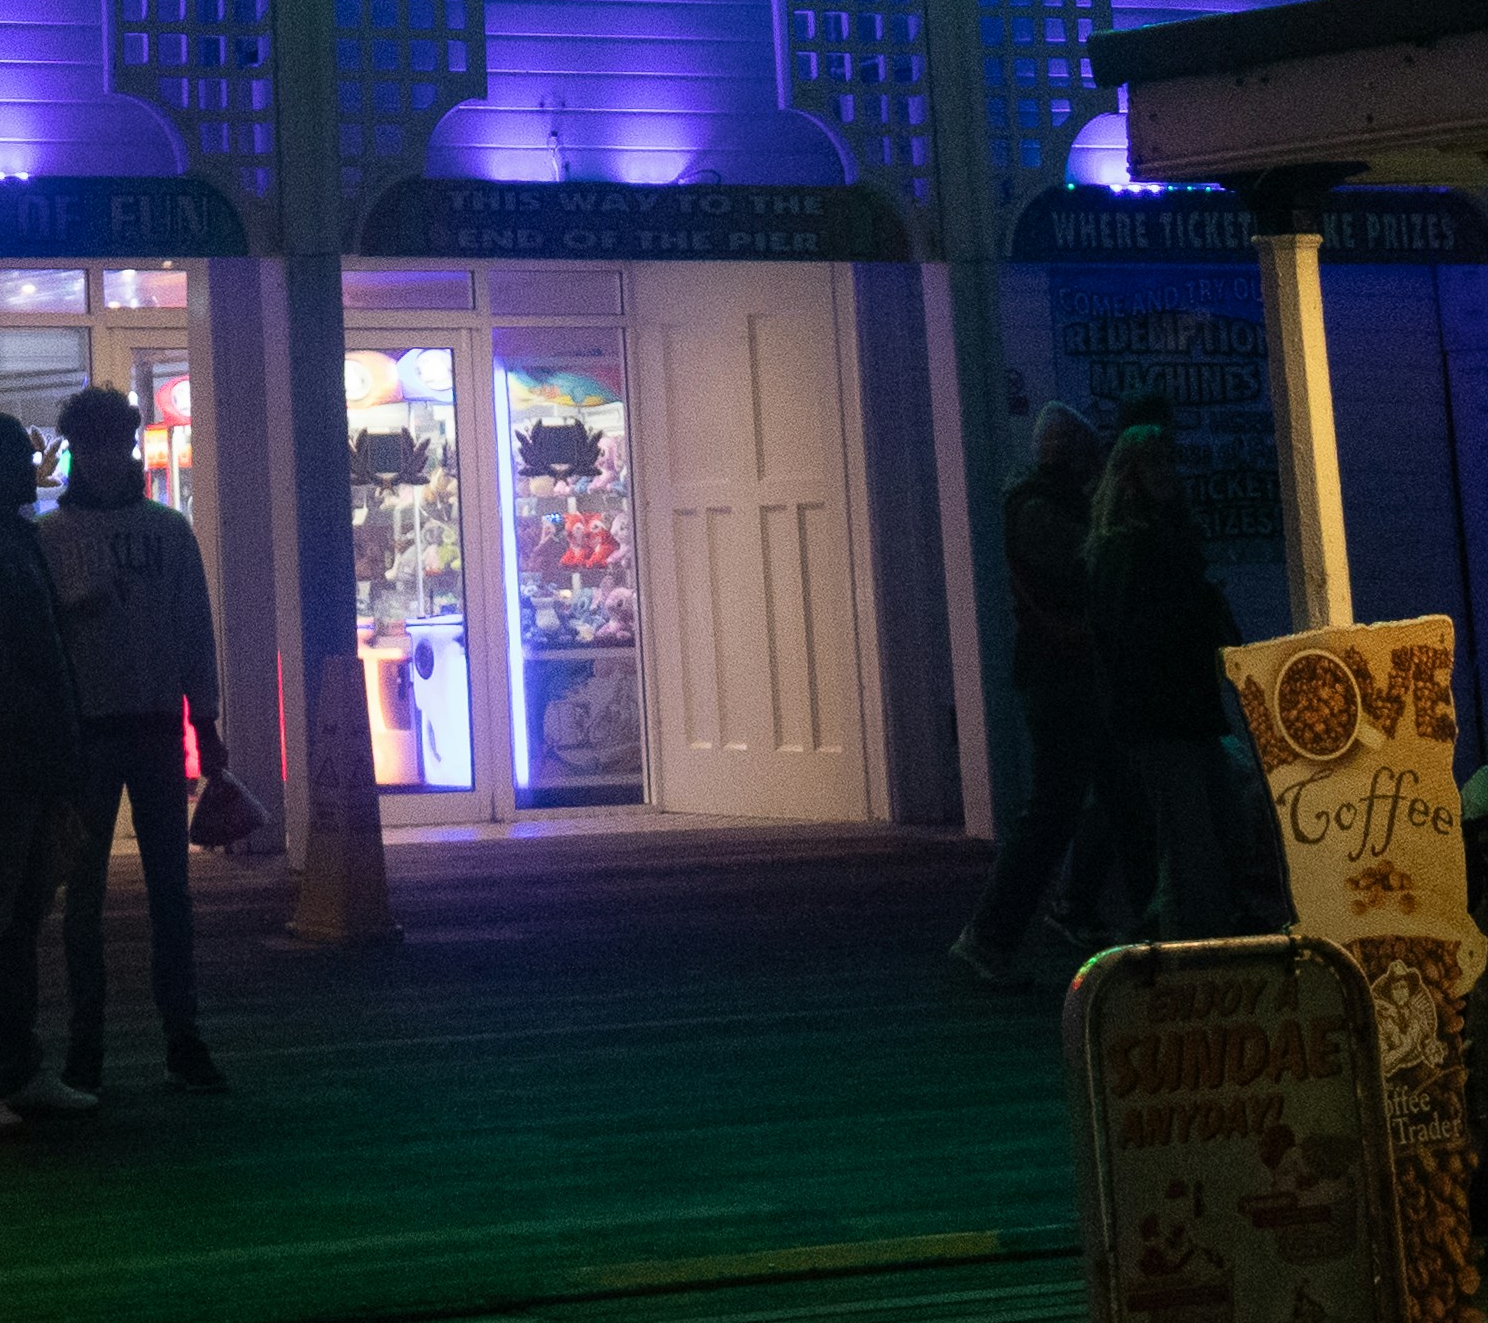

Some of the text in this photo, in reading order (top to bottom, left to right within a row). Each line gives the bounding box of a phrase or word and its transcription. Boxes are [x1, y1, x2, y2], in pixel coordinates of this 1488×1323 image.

[17, 192, 83, 243] OF
[108, 192, 210, 241] FUN
[446, 189, 824, 216] THIS WAY TO THE
[456, 228, 820, 254] END OF THE PIER
[1051, 210, 1148, 250] WHERE
[1161, 210, 1258, 250] TICKET
[1365, 210, 1455, 251] PRIZES
[1058, 287, 1127, 321] COME
[1133, 285, 1181, 316] AND
[1064, 309, 1268, 357] REDEMPTIO
[1089, 361, 1261, 404] MACHINES
[1182, 469, 1278, 503] TICKET
[1273, 765, 1455, 863] Coffee
[1146, 975, 1300, 1024] ENJOY A
[1107, 1015, 1346, 1099] SUNDAE
[1121, 1091, 1285, 1150] ANYDAY!
[1386, 1084, 1431, 1116] offee
[1392, 1110, 1462, 1145] Trader
